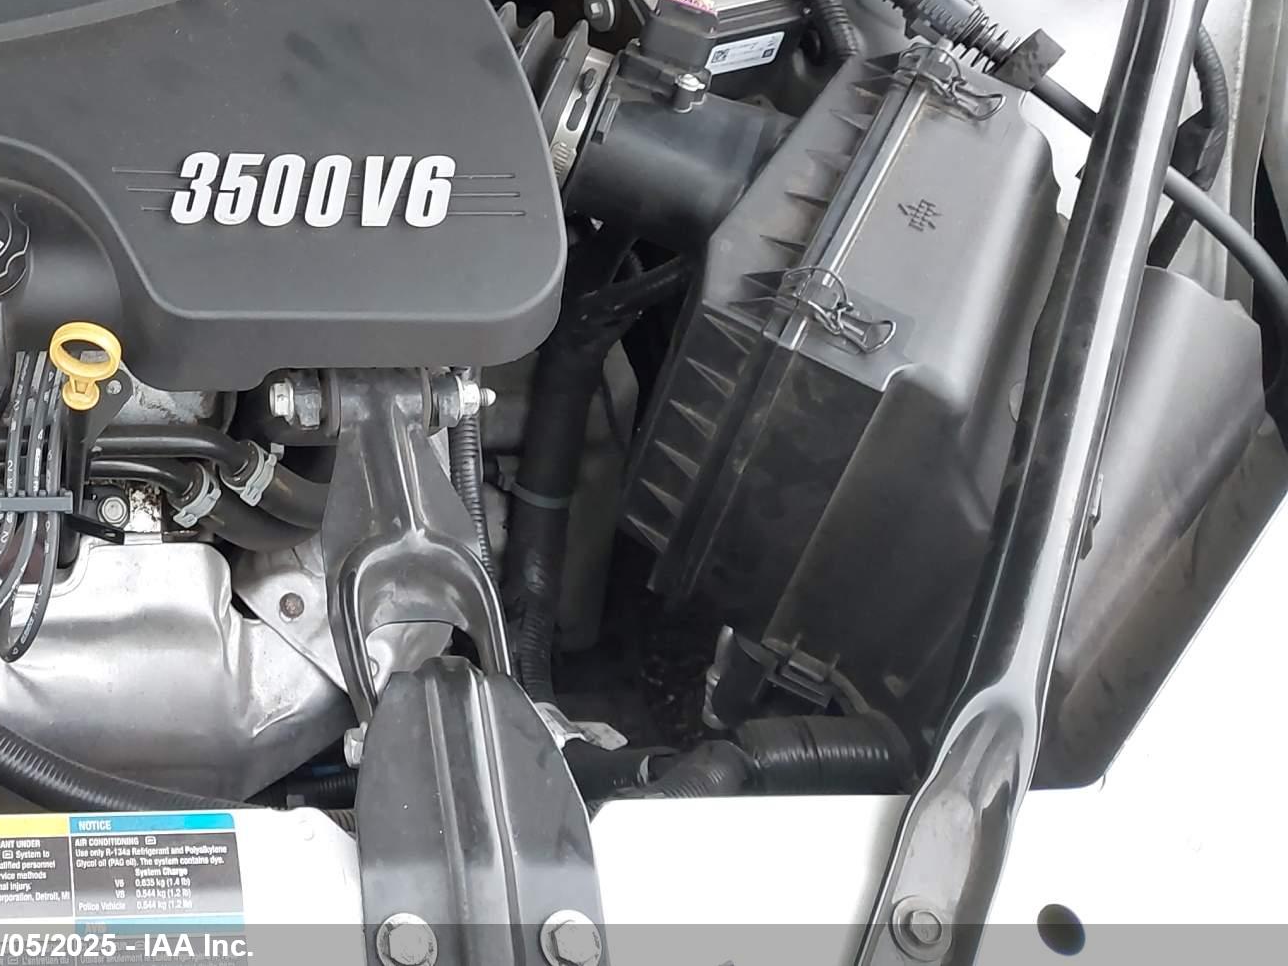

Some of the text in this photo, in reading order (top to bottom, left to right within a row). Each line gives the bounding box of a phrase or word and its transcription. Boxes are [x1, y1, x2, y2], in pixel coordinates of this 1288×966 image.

[170, 151, 457, 228] 3500 V6
[7, 460, 14, 472] 2
[78, 820, 112, 831] NOTICE
[16, 839, 41, 849] UNDER
[75, 837, 139, 848] AIR CONDITIONING
[15, 849, 41, 860] System
[42, 849, 50, 859] to
[75, 849, 89, 858] Use
[90, 848, 105, 859] only
[132, 846, 170, 857] Refrigerant
[170, 846, 184, 855] and
[185, 845, 228, 856] Polyalkylene
[21, 859, 56, 870] personnel
[76, 858, 96, 869] Glycol
[97, 858, 107, 868] oil
[108, 857, 125, 868] (PAG
[140, 857, 153, 866] The
[153, 856, 179, 867] system
[179, 855, 209, 865] contains
[16, 871, 47, 880] methods
[135, 867, 188, 878] System Charge
[156, 878, 166, 888] kg
[61, 891, 71, 900] MI
[157, 889, 167, 900] kg
[78, 902, 100, 912] Police
[101, 901, 126, 911] Vehicle
[158, 900, 168, 911] kg
